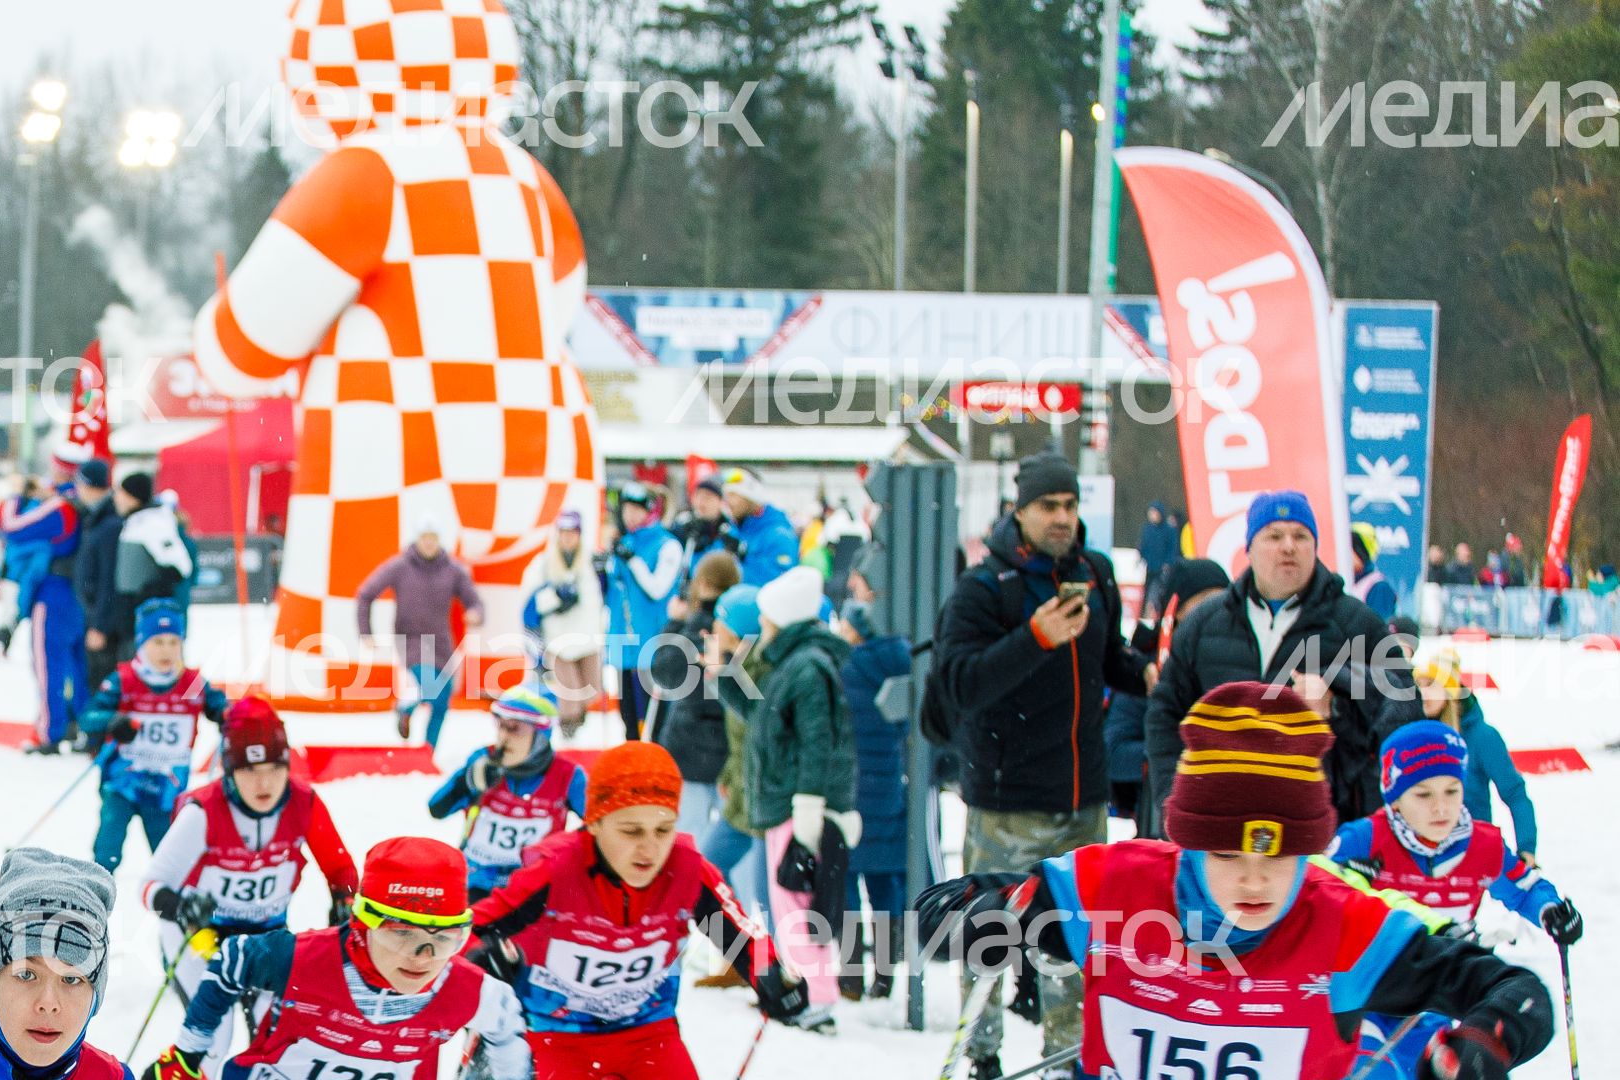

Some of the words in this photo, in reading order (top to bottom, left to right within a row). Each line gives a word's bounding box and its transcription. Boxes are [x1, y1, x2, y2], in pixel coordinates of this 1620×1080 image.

[831, 304, 1083, 357] ФИНИШ
[220, 875, 277, 901] 130
[573, 954, 654, 988] 129
